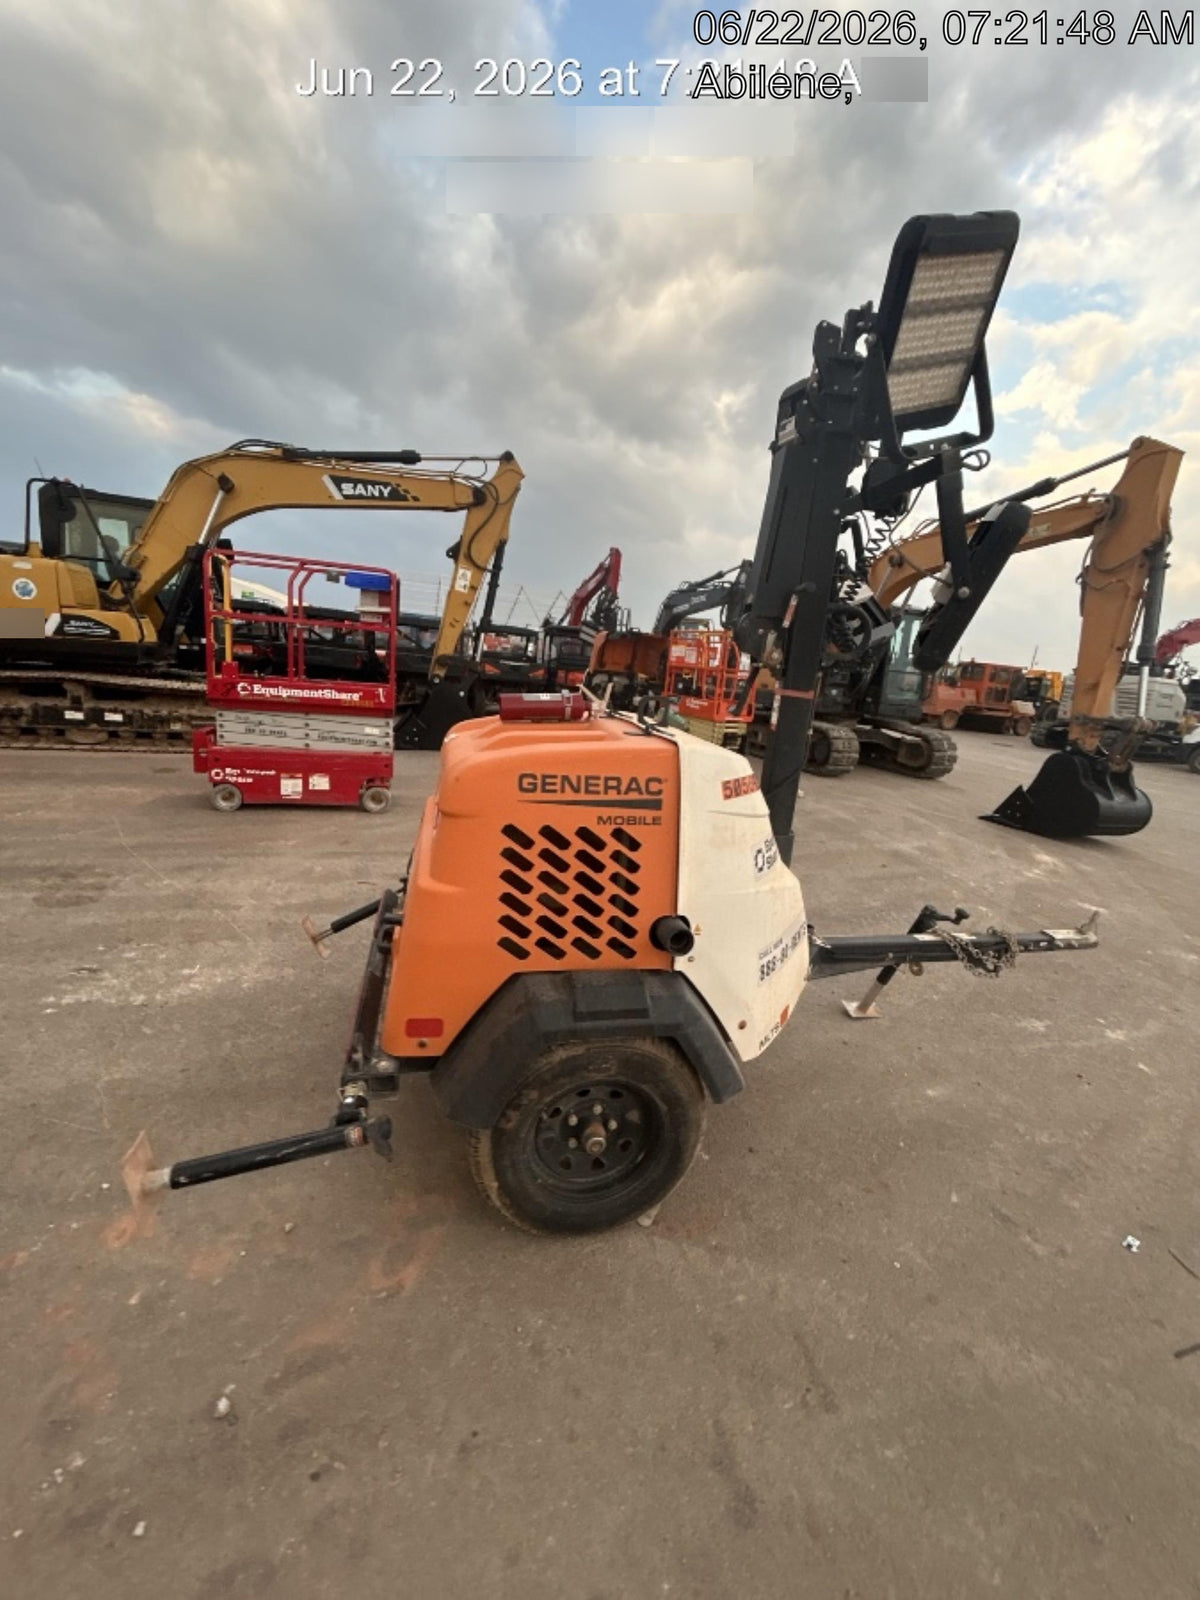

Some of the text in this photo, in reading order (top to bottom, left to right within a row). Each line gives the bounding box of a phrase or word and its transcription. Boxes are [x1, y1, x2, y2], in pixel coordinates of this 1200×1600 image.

[341, 483, 391, 497] SANY
[253, 684, 360, 701] EquipmentShare
[518, 773, 664, 796] GENERAC
[597, 815, 662, 826] MOBILE
